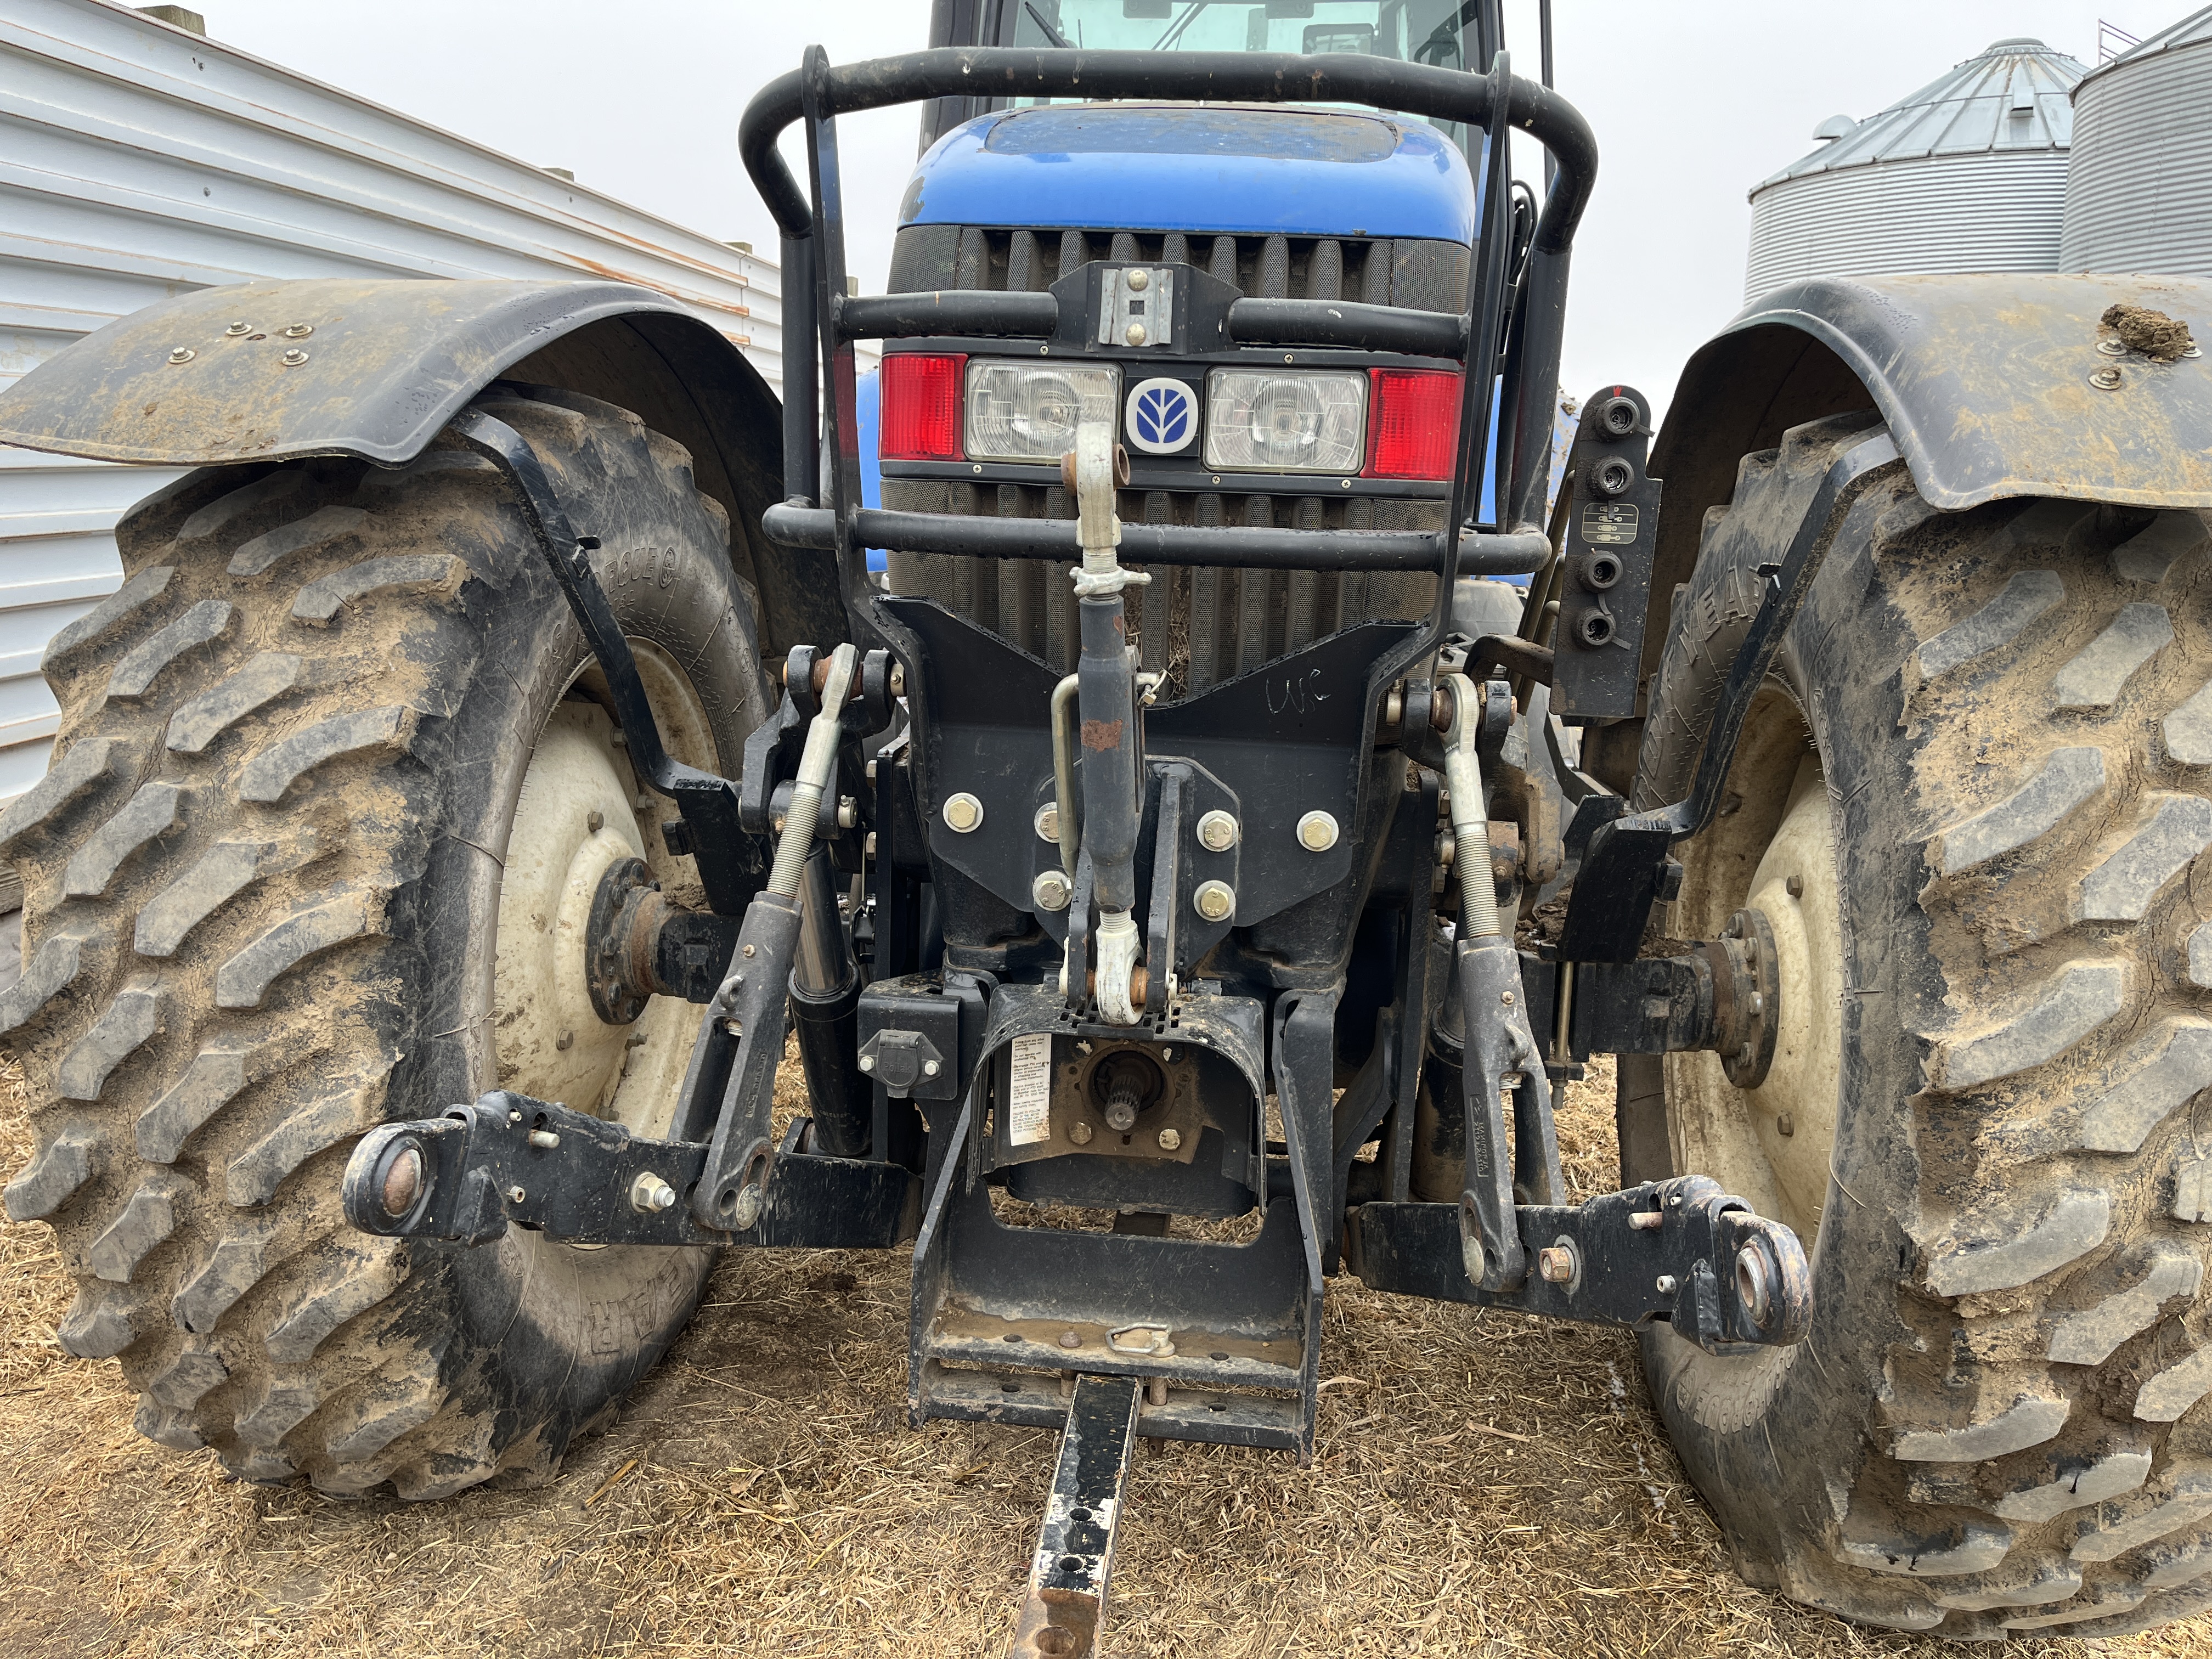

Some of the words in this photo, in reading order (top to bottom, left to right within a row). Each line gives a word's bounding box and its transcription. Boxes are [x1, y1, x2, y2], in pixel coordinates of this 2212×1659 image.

[593, 545, 658, 596] RQUE
[1204, 828, 1215, 844] 8.8
[1205, 906, 1221, 916] 8.8
